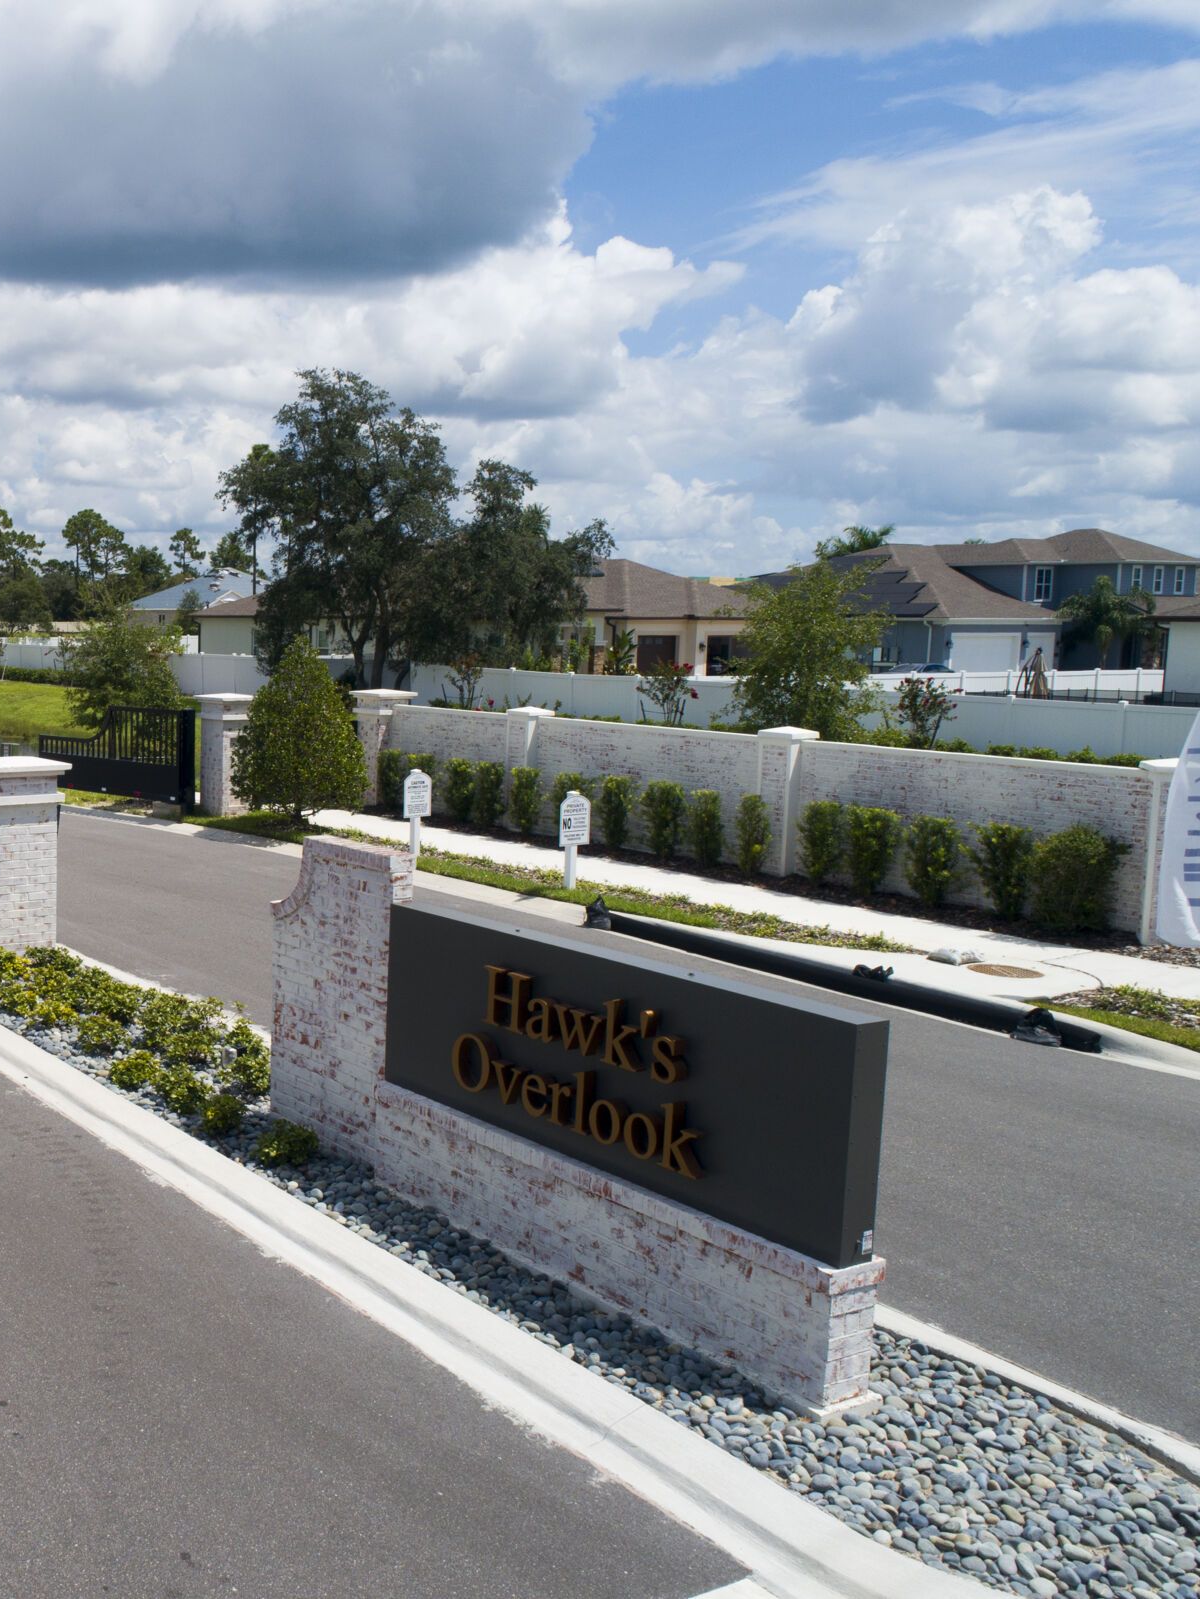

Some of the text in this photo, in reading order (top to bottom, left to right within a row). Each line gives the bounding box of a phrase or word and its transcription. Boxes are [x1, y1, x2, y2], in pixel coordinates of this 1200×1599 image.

[562, 817, 572, 829] NO
[482, 964, 688, 1084] Hawk's
[452, 1032, 705, 1180] Overlook
